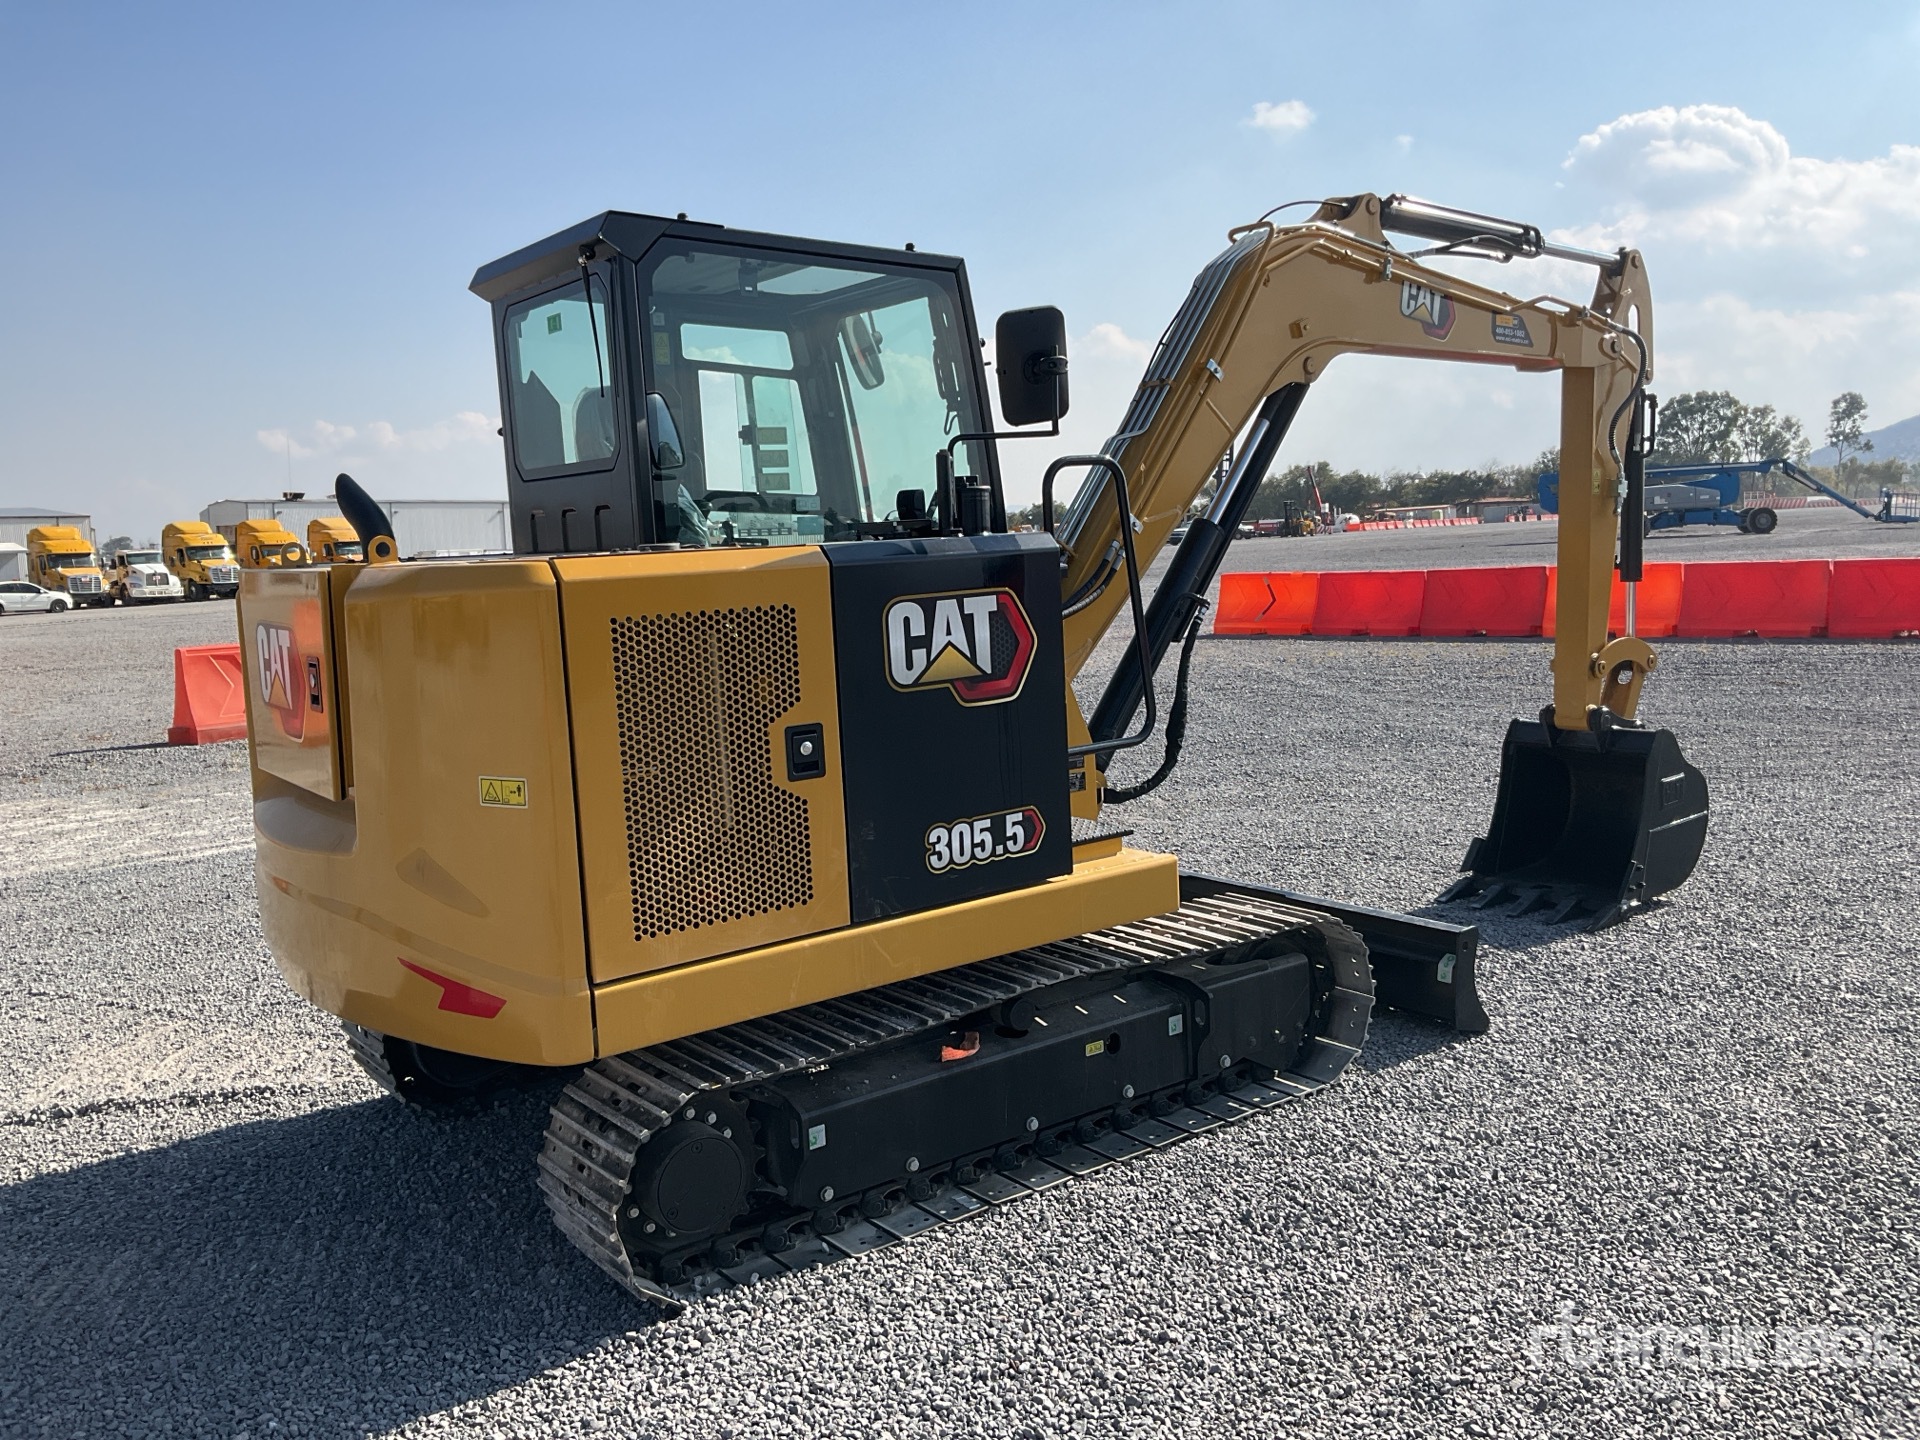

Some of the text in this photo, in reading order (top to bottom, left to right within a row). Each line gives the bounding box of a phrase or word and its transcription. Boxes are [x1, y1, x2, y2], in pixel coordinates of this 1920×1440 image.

[1401, 280, 1445, 326] CAT
[257, 625, 293, 710] CAT
[888, 595, 998, 685] CAT
[929, 812, 1025, 868] 305.5
